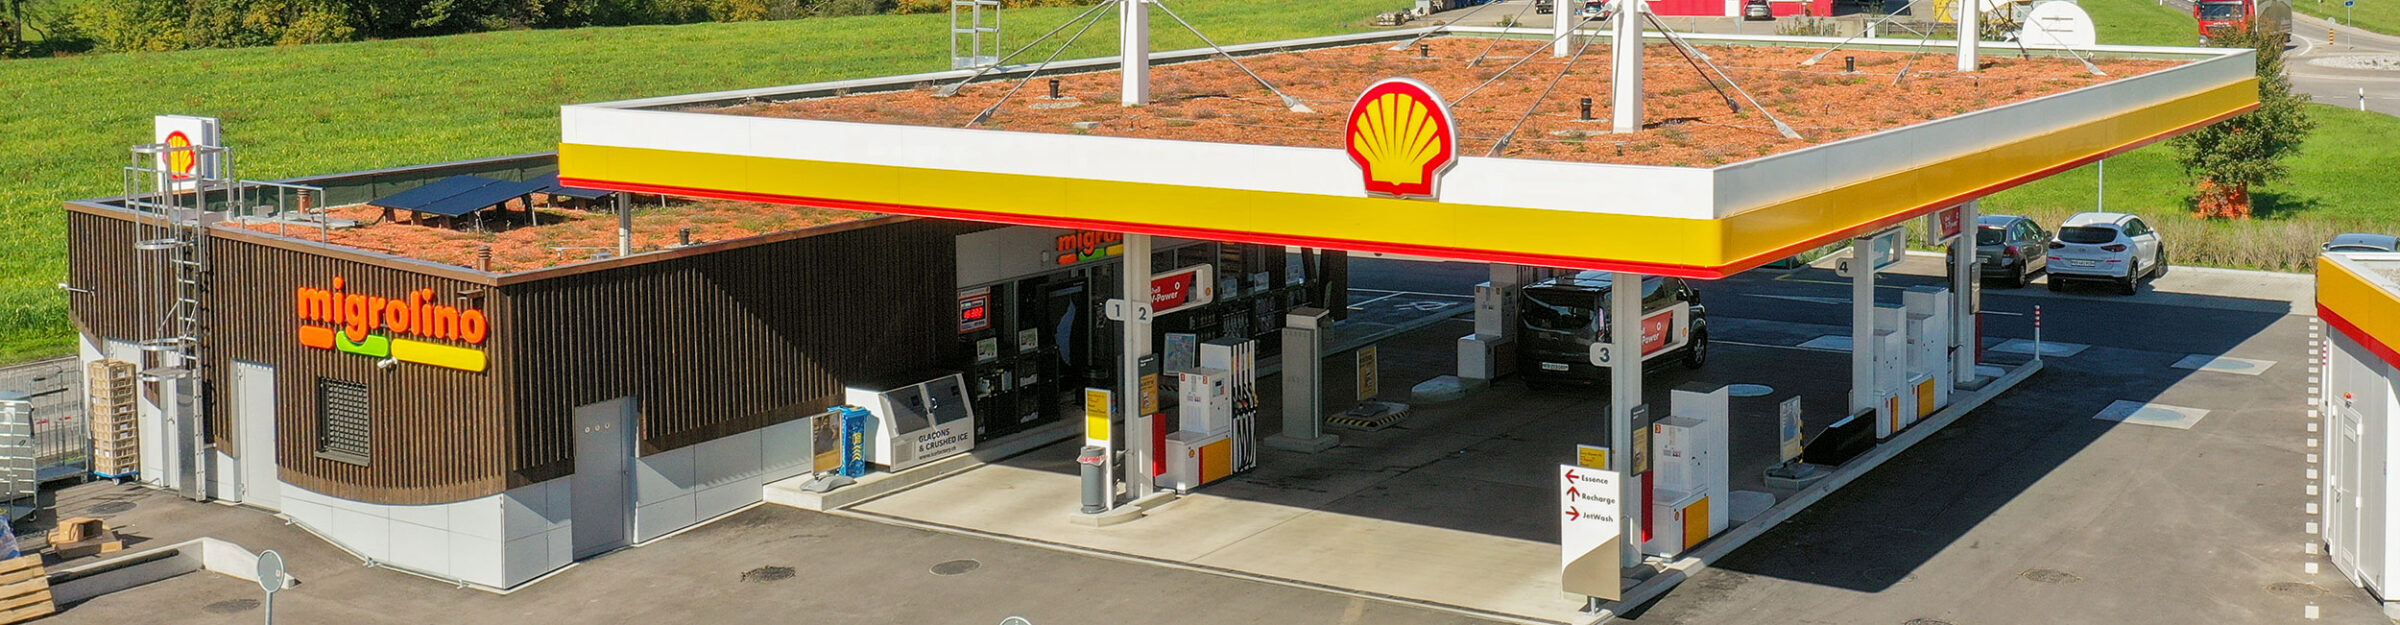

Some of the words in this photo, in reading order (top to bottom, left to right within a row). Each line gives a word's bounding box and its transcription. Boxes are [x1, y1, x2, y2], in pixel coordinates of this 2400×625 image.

[1839, 261, 1848, 273] 4
[298, 276, 487, 344] migrolino
[1115, 304, 1120, 317] 1
[1138, 307, 1147, 320] 2
[1599, 347, 1610, 363] 3
[918, 428, 950, 443] GLAÇONS
[919, 444, 924, 452] &
[925, 436, 956, 450] CRUSHED
[957, 432, 968, 442] ICE
[1581, 474, 1608, 485] Essence
[1582, 492, 1616, 505] Recharge
[1583, 512, 1614, 522] JetWash
